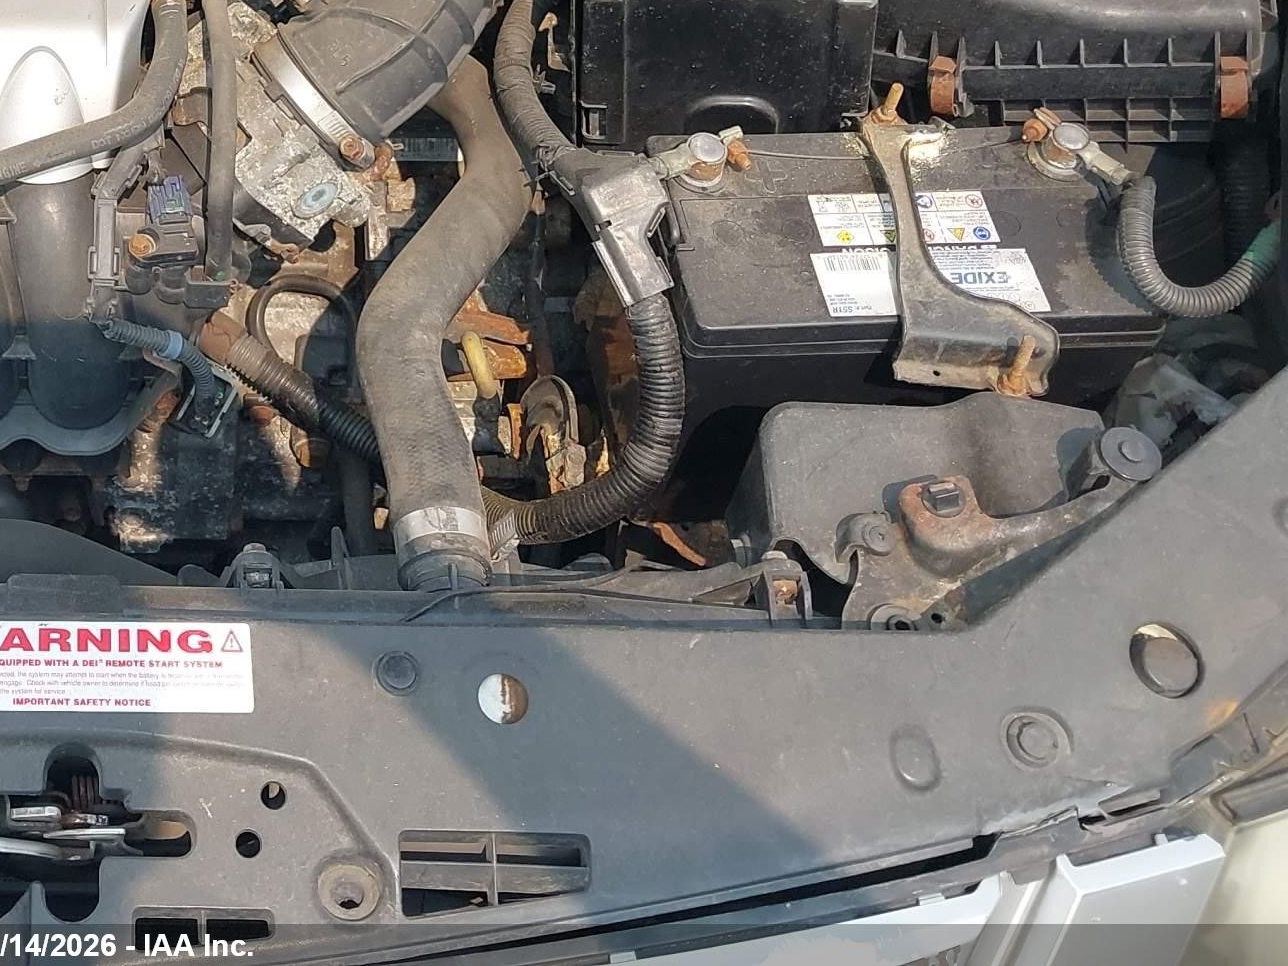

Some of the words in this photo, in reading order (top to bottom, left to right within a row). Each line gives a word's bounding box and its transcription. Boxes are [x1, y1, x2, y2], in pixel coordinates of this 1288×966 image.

[950, 271, 1009, 285] EXIDE
[44, 659, 70, 667] WITH
[72, 659, 80, 667] A
[105, 659, 146, 668] REMOTE
[148, 659, 180, 668] START
[183, 660, 223, 668] SYSTEM
[12, 697, 71, 707] IMPORTANT
[73, 698, 112, 707] SAFETY
[114, 698, 152, 707] NOTICE
